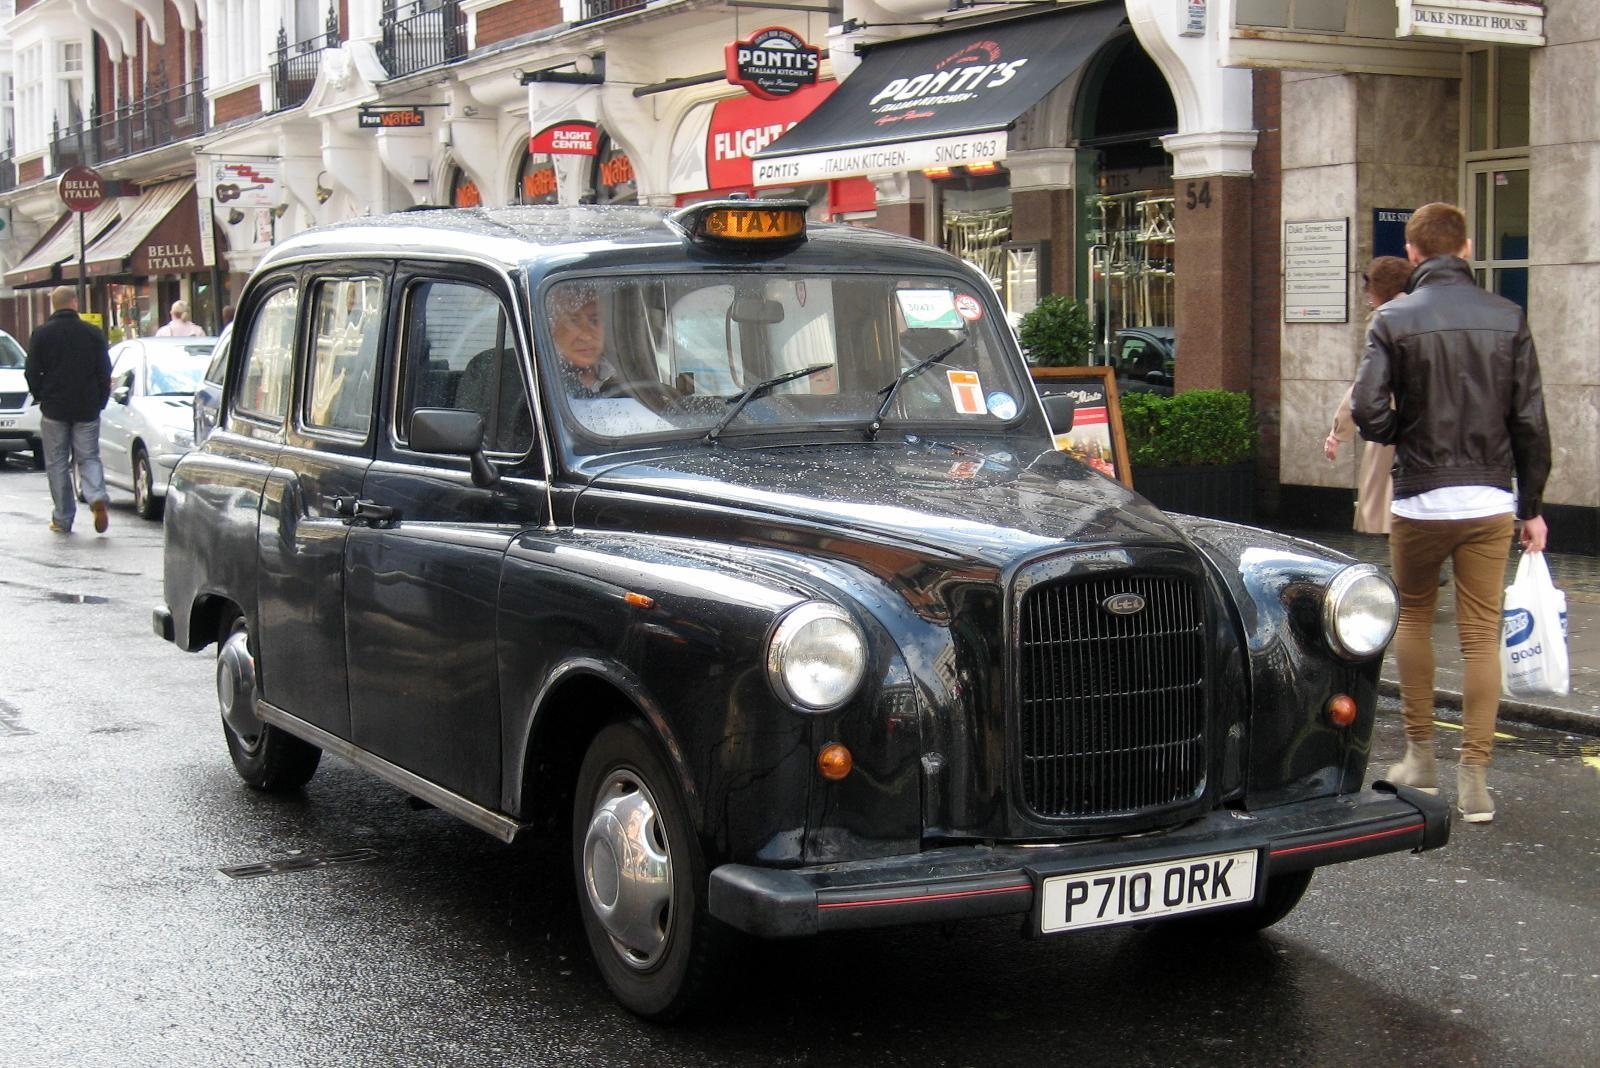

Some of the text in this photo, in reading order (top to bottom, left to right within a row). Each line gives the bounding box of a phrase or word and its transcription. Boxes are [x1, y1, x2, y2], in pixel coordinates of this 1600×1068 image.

[1415, 9, 1528, 31] DUKE STREET HOUSE
[738, 49, 818, 69] PONTI'S
[869, 58, 1029, 106] PONTI'S
[552, 140, 593, 150] CENTRE
[553, 130, 592, 141] FLIGHT
[714, 124, 783, 161] FLIGHT
[759, 162, 800, 179] PONTI'S
[935, 143, 967, 162] SINCE
[971, 140, 997, 158] 1963
[64, 189, 101, 199] ITALIA
[65, 180, 100, 189] BELLA
[1186, 181, 1213, 210] 54
[731, 210, 789, 233] TAXI
[148, 244, 192, 257] BELLA
[148, 256, 195, 269] ITALIA
[1511, 641, 1543, 664] good
[1065, 858, 1235, 923] P710 ORK
